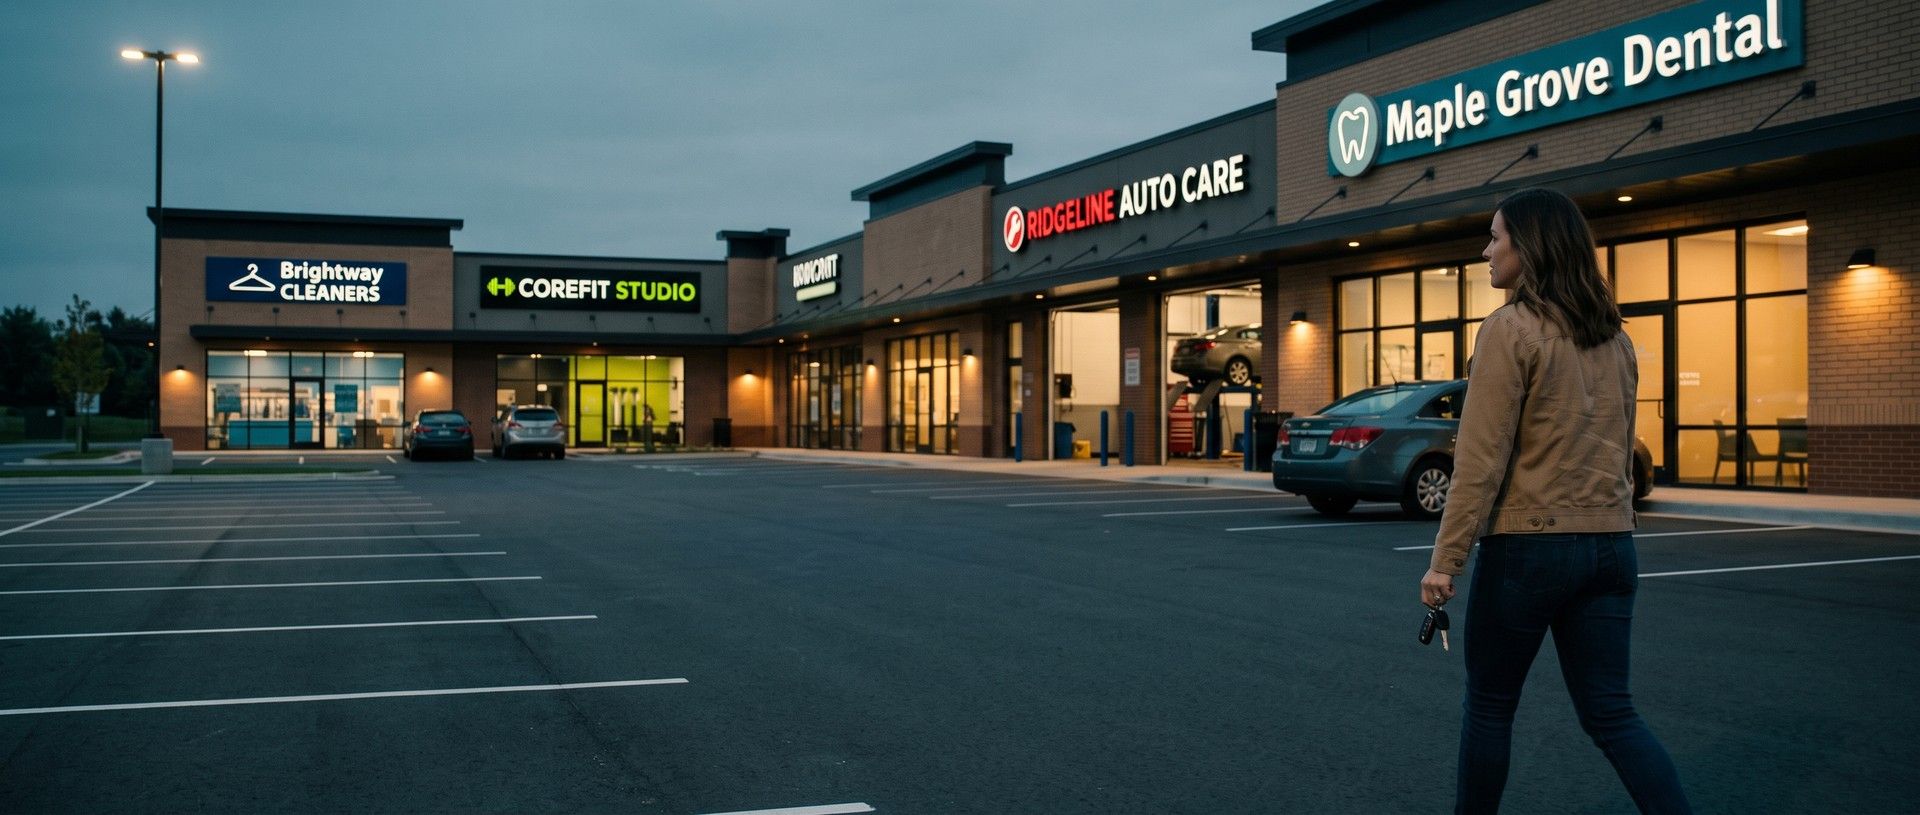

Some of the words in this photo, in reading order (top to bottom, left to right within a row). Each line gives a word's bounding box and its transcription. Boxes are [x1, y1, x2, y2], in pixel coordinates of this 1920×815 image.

[1386, 83, 1485, 146] Maple
[1496, 56, 1609, 117] Grove
[1624, 0, 1783, 87] Dental
[1027, 188, 1115, 240] RIDGELINE
[1119, 173, 1176, 219] AUTO
[1181, 154, 1244, 204] CARE
[280, 261, 384, 285] Brightway
[280, 283, 381, 302] CLEANERS
[518, 278, 610, 299] COREFIT
[615, 281, 696, 302] STUDIO
